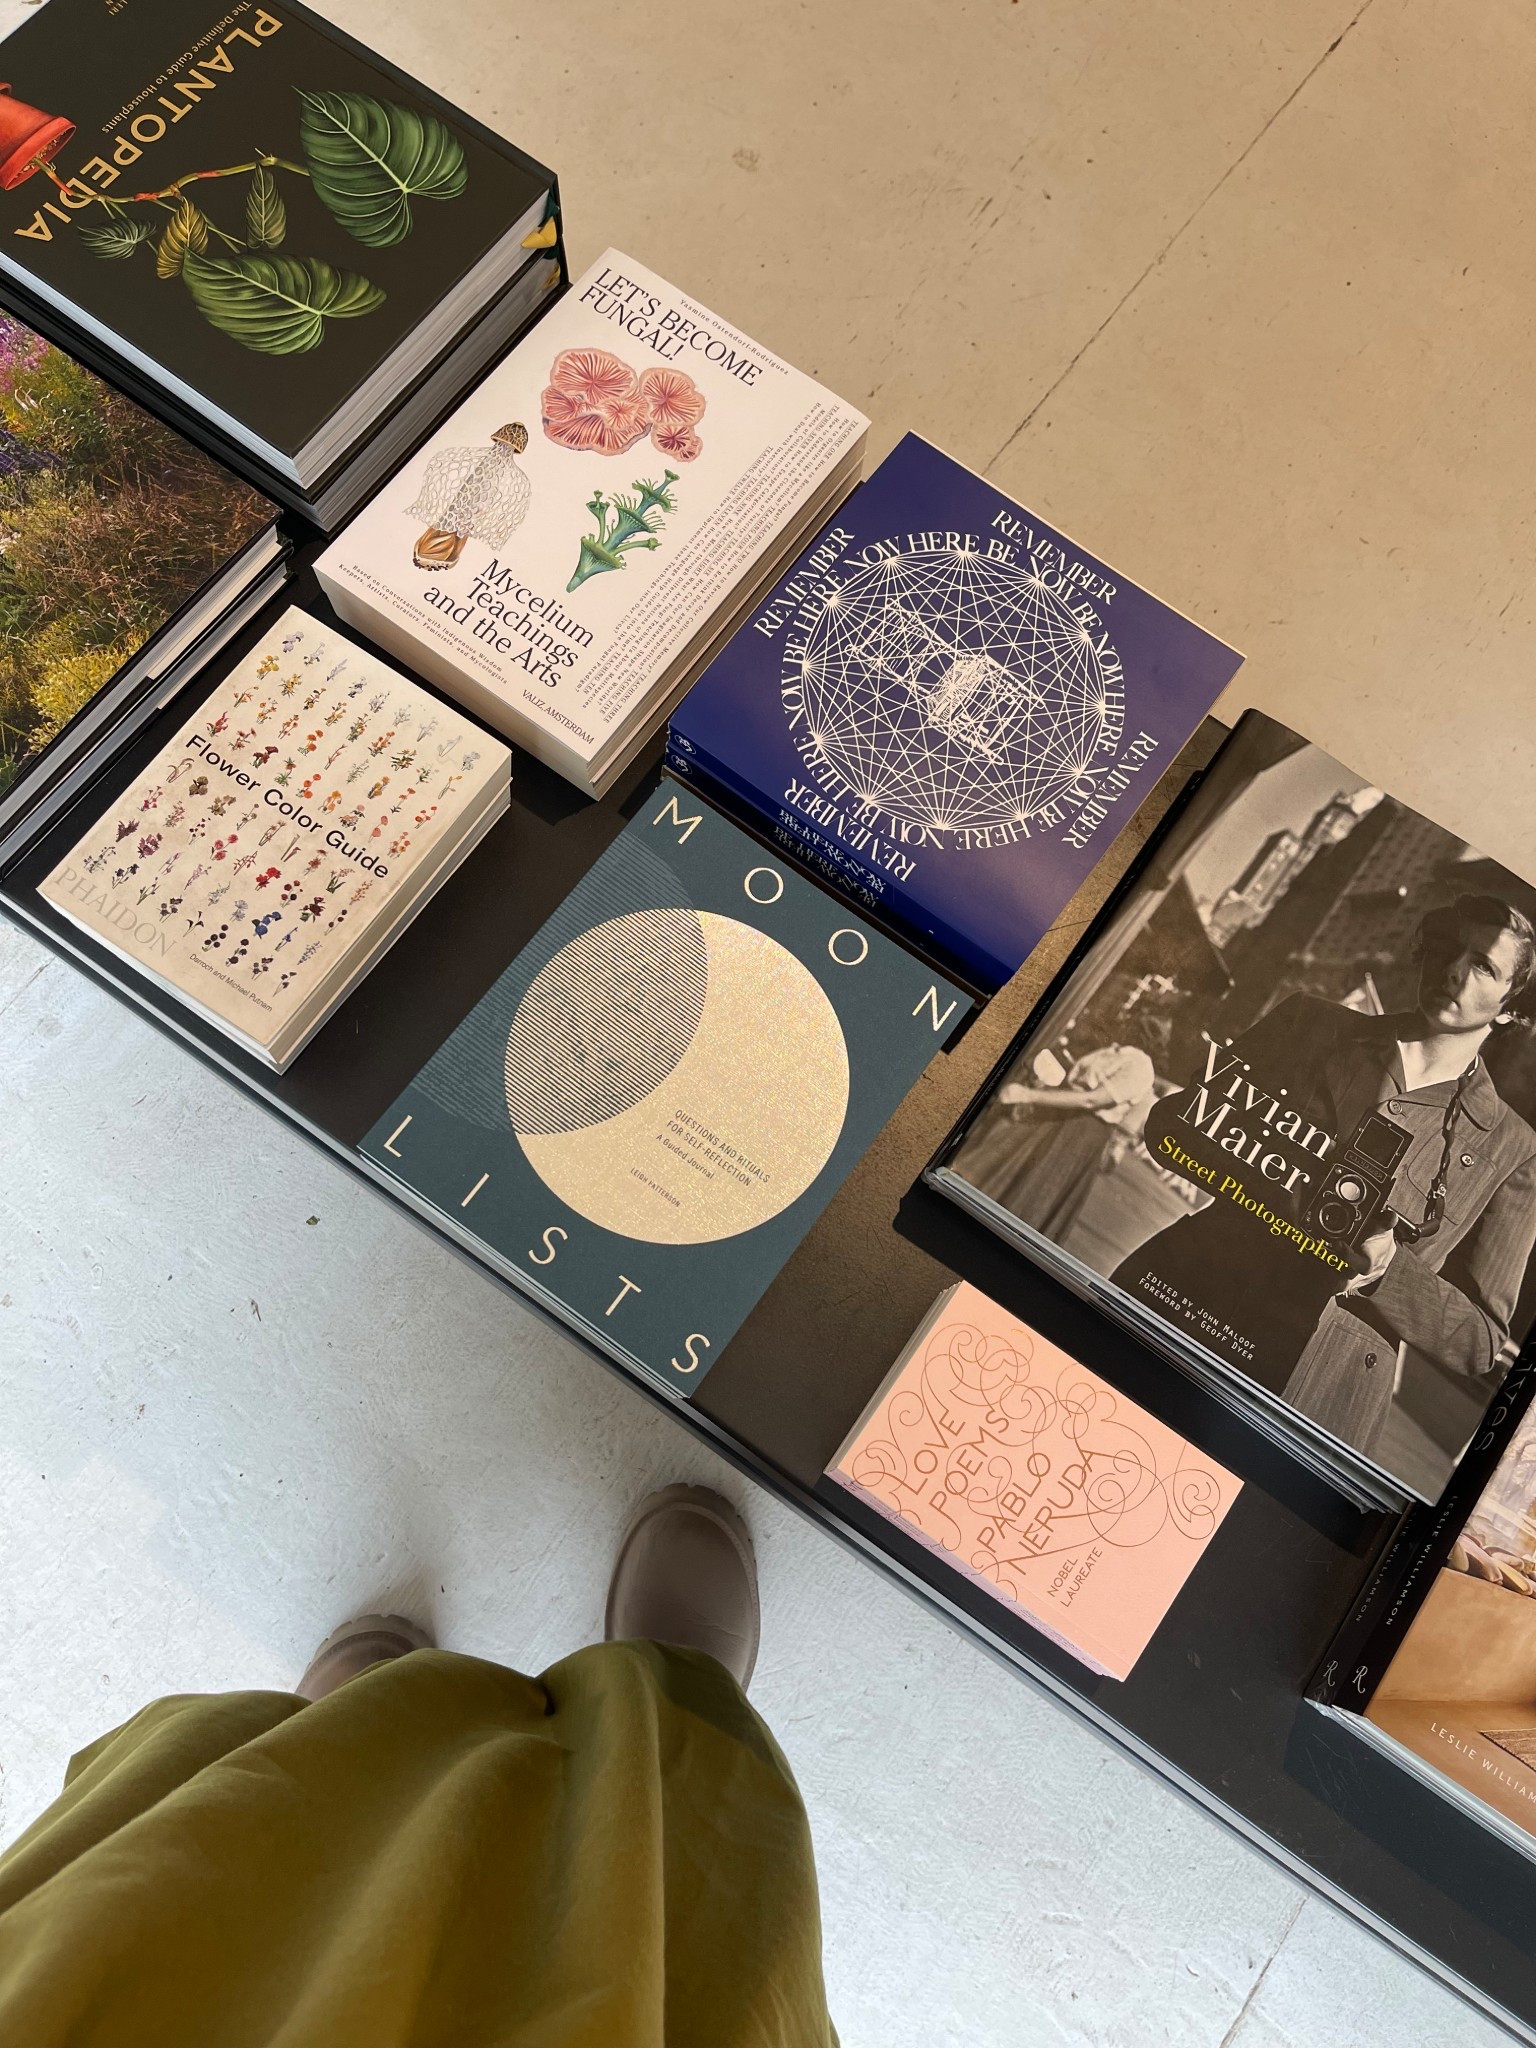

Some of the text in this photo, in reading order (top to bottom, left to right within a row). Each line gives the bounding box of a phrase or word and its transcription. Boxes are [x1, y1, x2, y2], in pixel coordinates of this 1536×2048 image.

[101, 0, 252, 133] The Definitive Guide to Houseplants
[16, 9, 282, 241] PLANTOPEDIA
[578, 285, 684, 360] FUNGAL!
[680, 299, 709, 321] Yasmine
[657, 308, 763, 386] BECOME
[843, 535, 908, 577] NOW
[906, 530, 981, 552] HERE
[986, 536, 1022, 564] BE
[990, 510, 1118, 607] REMEMBER
[475, 558, 593, 648] Mycelium
[752, 528, 856, 639] REMEMBER
[792, 567, 849, 632] HERE
[1023, 553, 1083, 605] NOW
[423, 586, 561, 687] and the Arts
[466, 576, 578, 667] Teachings
[782, 631, 809, 664] BE
[1072, 599, 1105, 632] BE
[781, 669, 808, 729] NOW
[791, 730, 850, 801] HERE
[1056, 758, 1107, 813] NOW
[1060, 730, 1159, 850] REMEMBER
[185, 733, 388, 878] Flower Color Guide
[784, 777, 917, 882] REMEMBER
[842, 793, 882, 827] BE
[878, 813, 944, 849] NOW
[953, 818, 1032, 850] HERE
[1029, 801, 1066, 832] BE
[53, 866, 177, 956] PHAIDON
[188, 952, 272, 1012] Darroch and Michael Putnam
[1197, 1030, 1334, 1160] Vivian
[654, 1132, 715, 1179] A Guided Journal
[666, 1119, 751, 1186] FOR SELF-REFLECTION
[674, 1109, 770, 1183] QUESTIONS AND RITUALS
[1177, 1084, 1310, 1193] Maier
[1157, 1135, 1348, 1271] Street Photographer
[897, 1408, 966, 1495] LOVE
[928, 1407, 1009, 1518] POEMS
[976, 1450, 1051, 1553] PABLO
[1005, 1446, 1095, 1575] NERUDA
[1432, 1496, 1458, 1538] LESLIE
[1046, 1557, 1078, 1598] NOBEL
[1059, 1546, 1102, 1607] LAUREATE
[1386, 1544, 1432, 1626] WILLIAMSON
[1430, 1722, 1476, 1760] LESLIE
